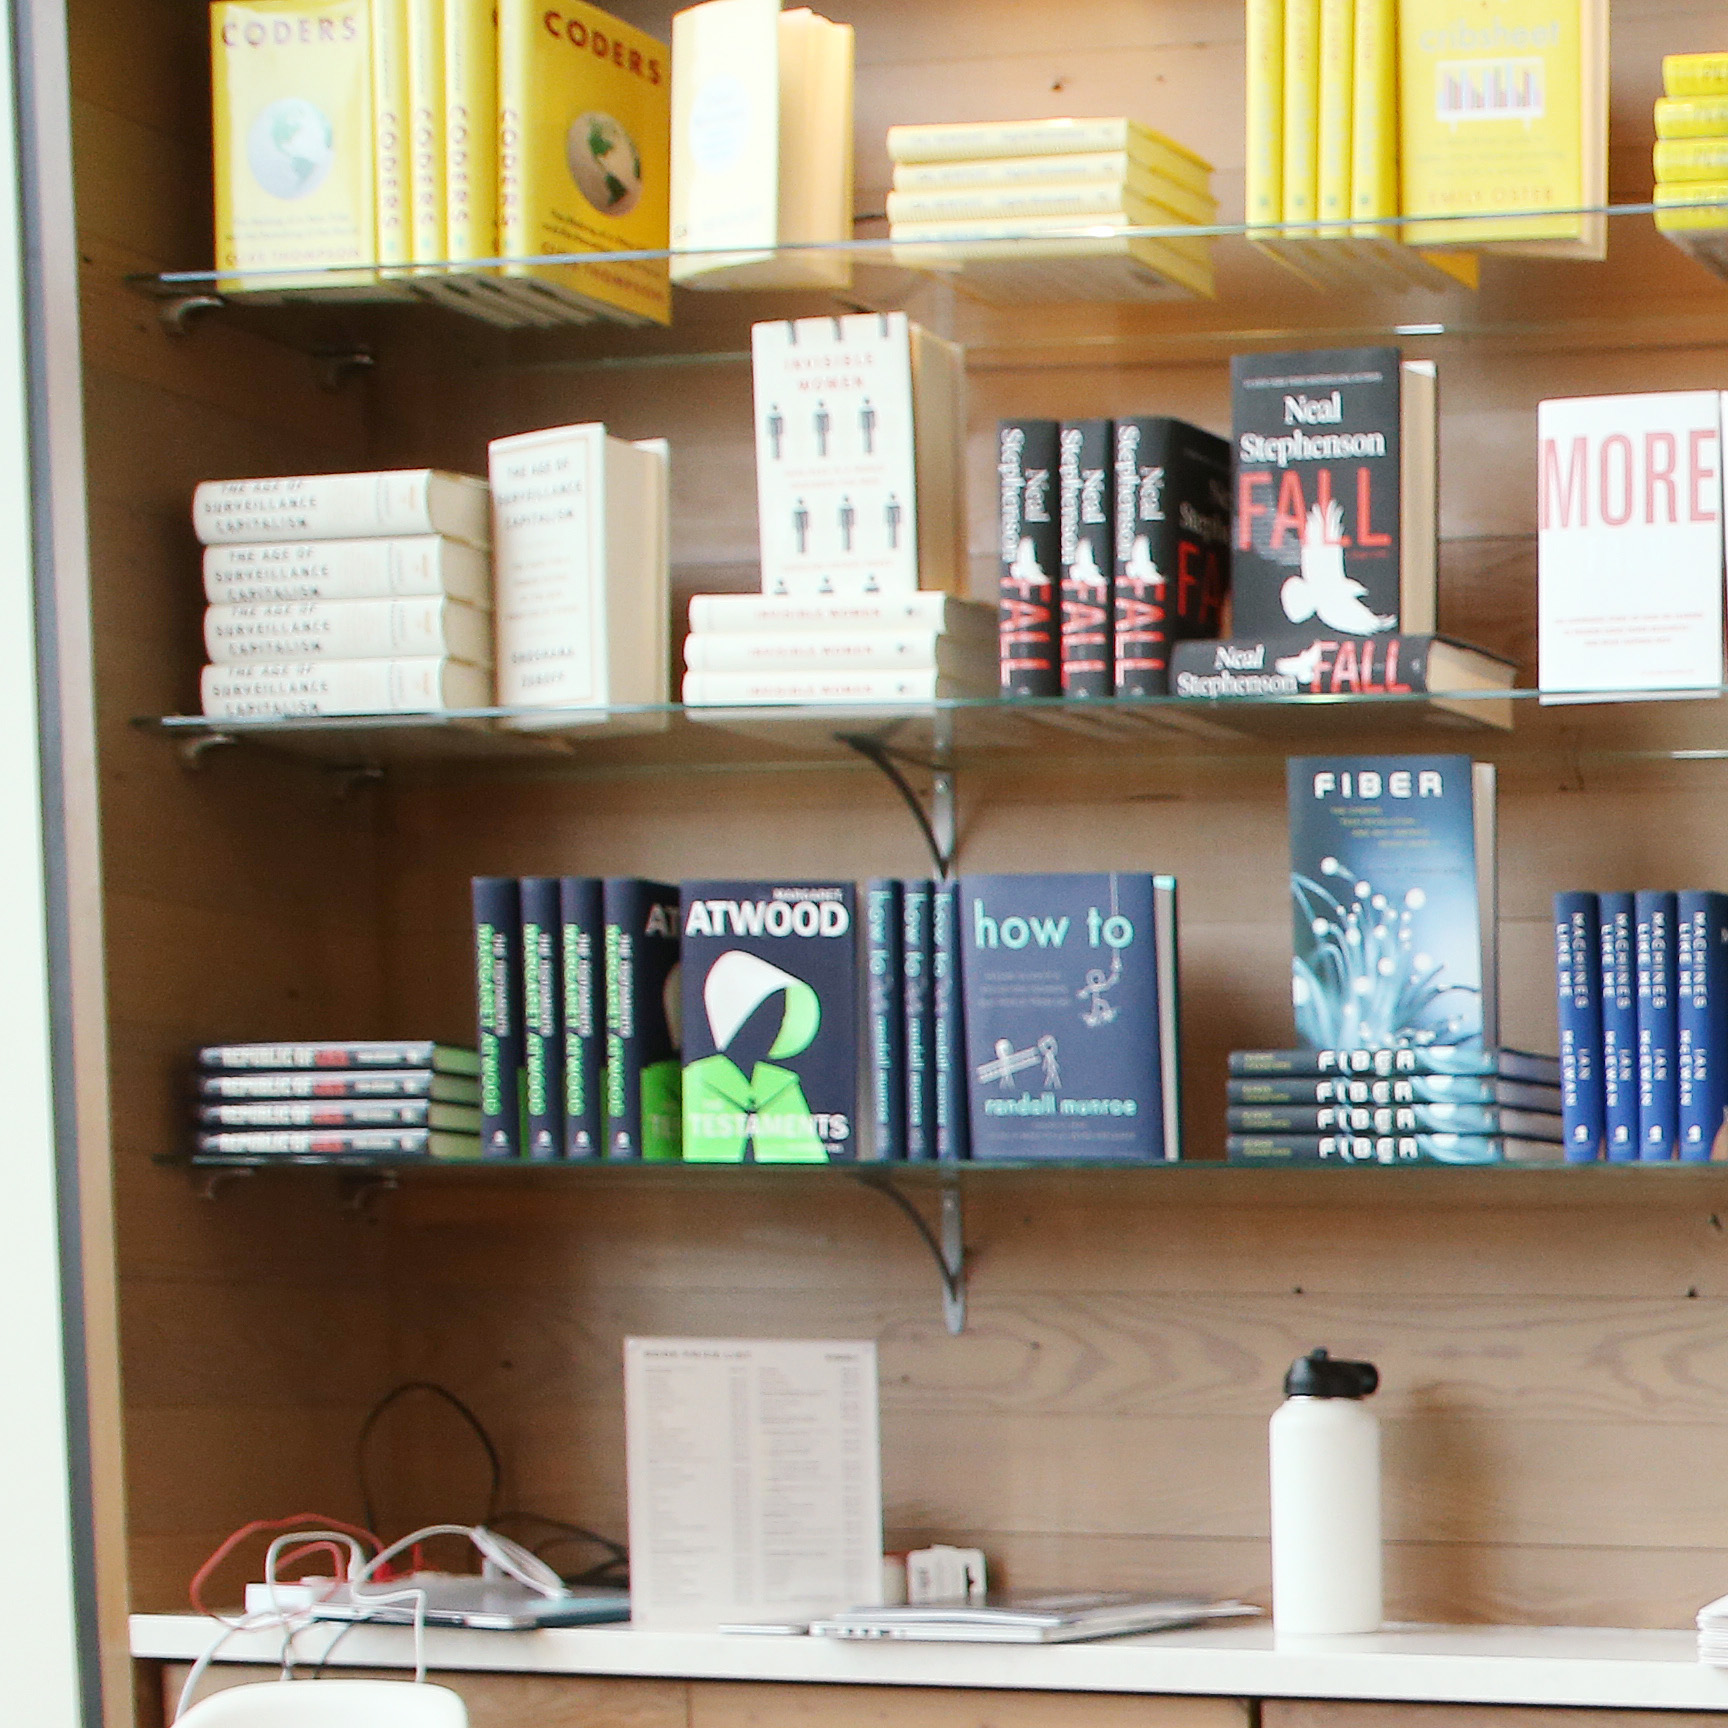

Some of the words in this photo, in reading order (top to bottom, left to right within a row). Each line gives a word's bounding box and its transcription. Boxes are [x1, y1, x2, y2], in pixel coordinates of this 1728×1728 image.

[223, 16, 357, 46] CODERS
[544, 11, 662, 84] CODERS
[1283, 391, 1343, 426] Neal
[1240, 429, 1386, 467] Stephenson
[1542, 429, 1718, 532] MORE
[1237, 467, 1392, 549] FALL
[1314, 770, 1444, 800] FIBER
[685, 900, 850, 937] ATWOOD
[974, 899, 1071, 950] how
[1086, 906, 1134, 948] to
[984, 1092, 1056, 1117] randall
[1059, 1098, 1138, 1117] munroe
[689, 1113, 850, 1140] TESTAMENTS
